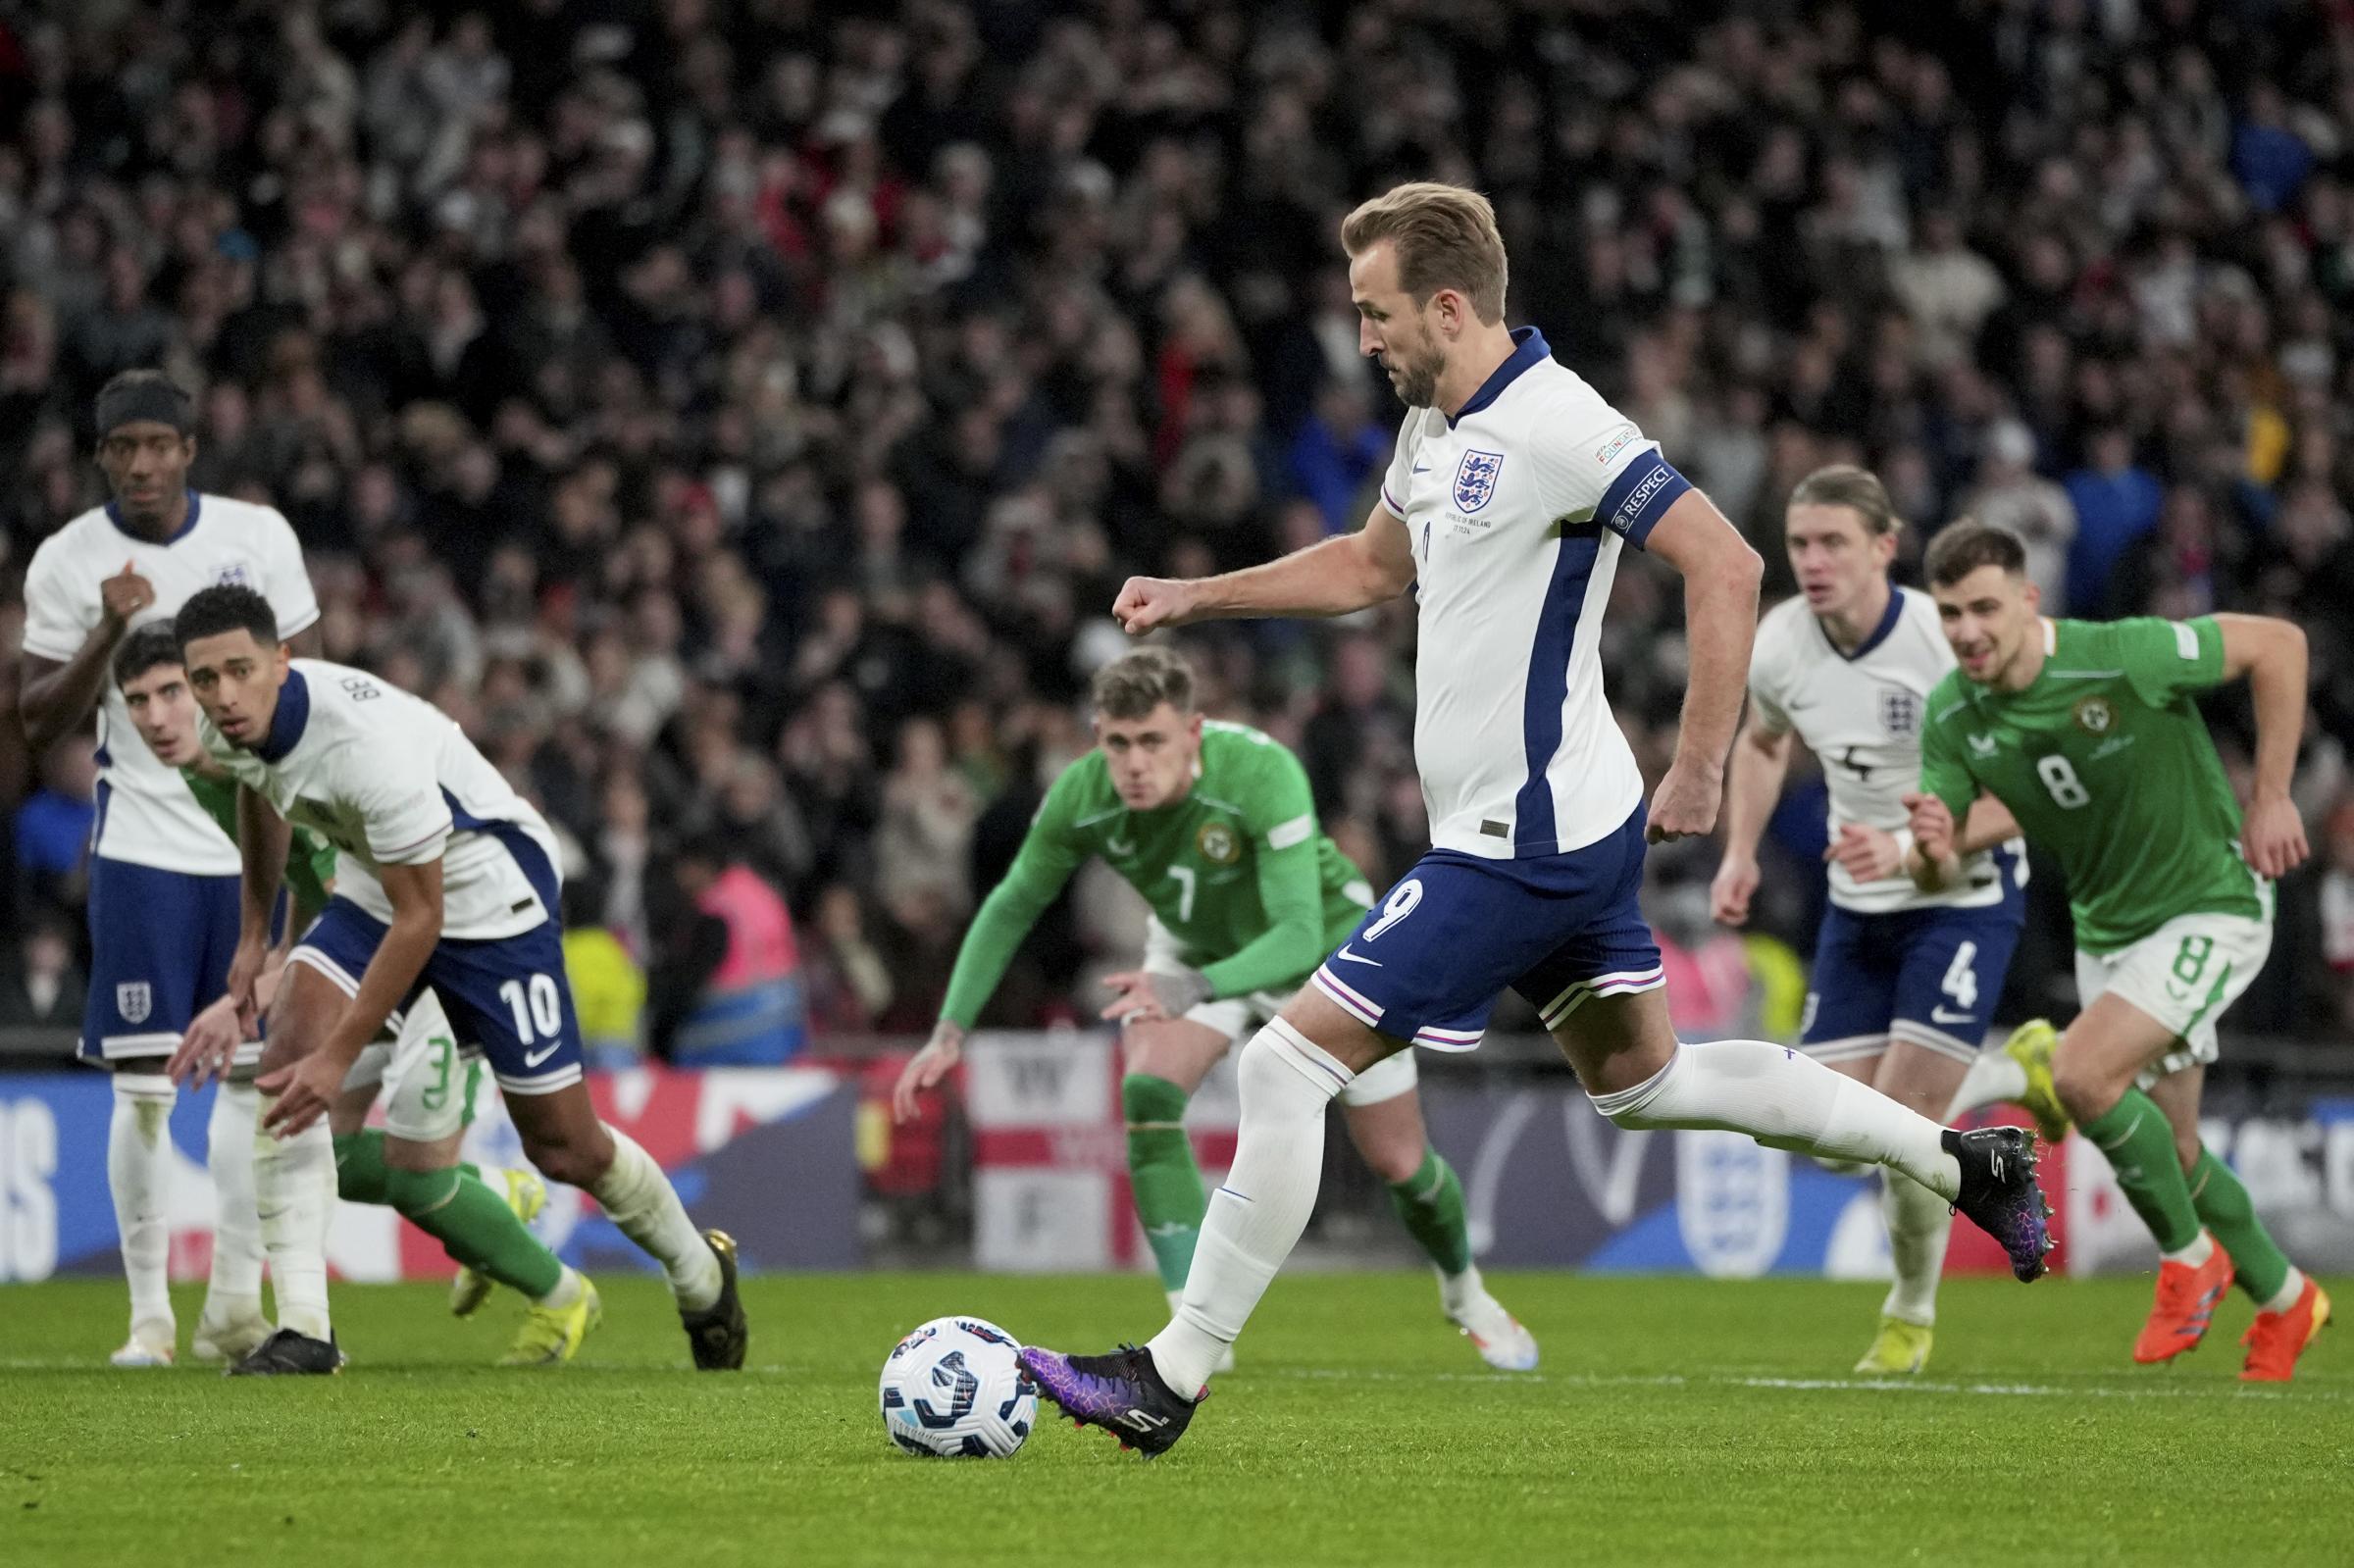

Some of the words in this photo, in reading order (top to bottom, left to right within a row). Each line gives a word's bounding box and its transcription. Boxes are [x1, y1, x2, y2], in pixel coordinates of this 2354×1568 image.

[1624, 467, 1669, 516] RESPECT
[2036, 754, 2090, 809] 8
[1166, 865, 1195, 922] 7
[1362, 879, 1423, 942] 9
[1941, 940, 1978, 1009] 4
[2173, 934, 2214, 986] 8
[498, 972, 562, 1046] 10
[423, 1037, 452, 1110] 3
